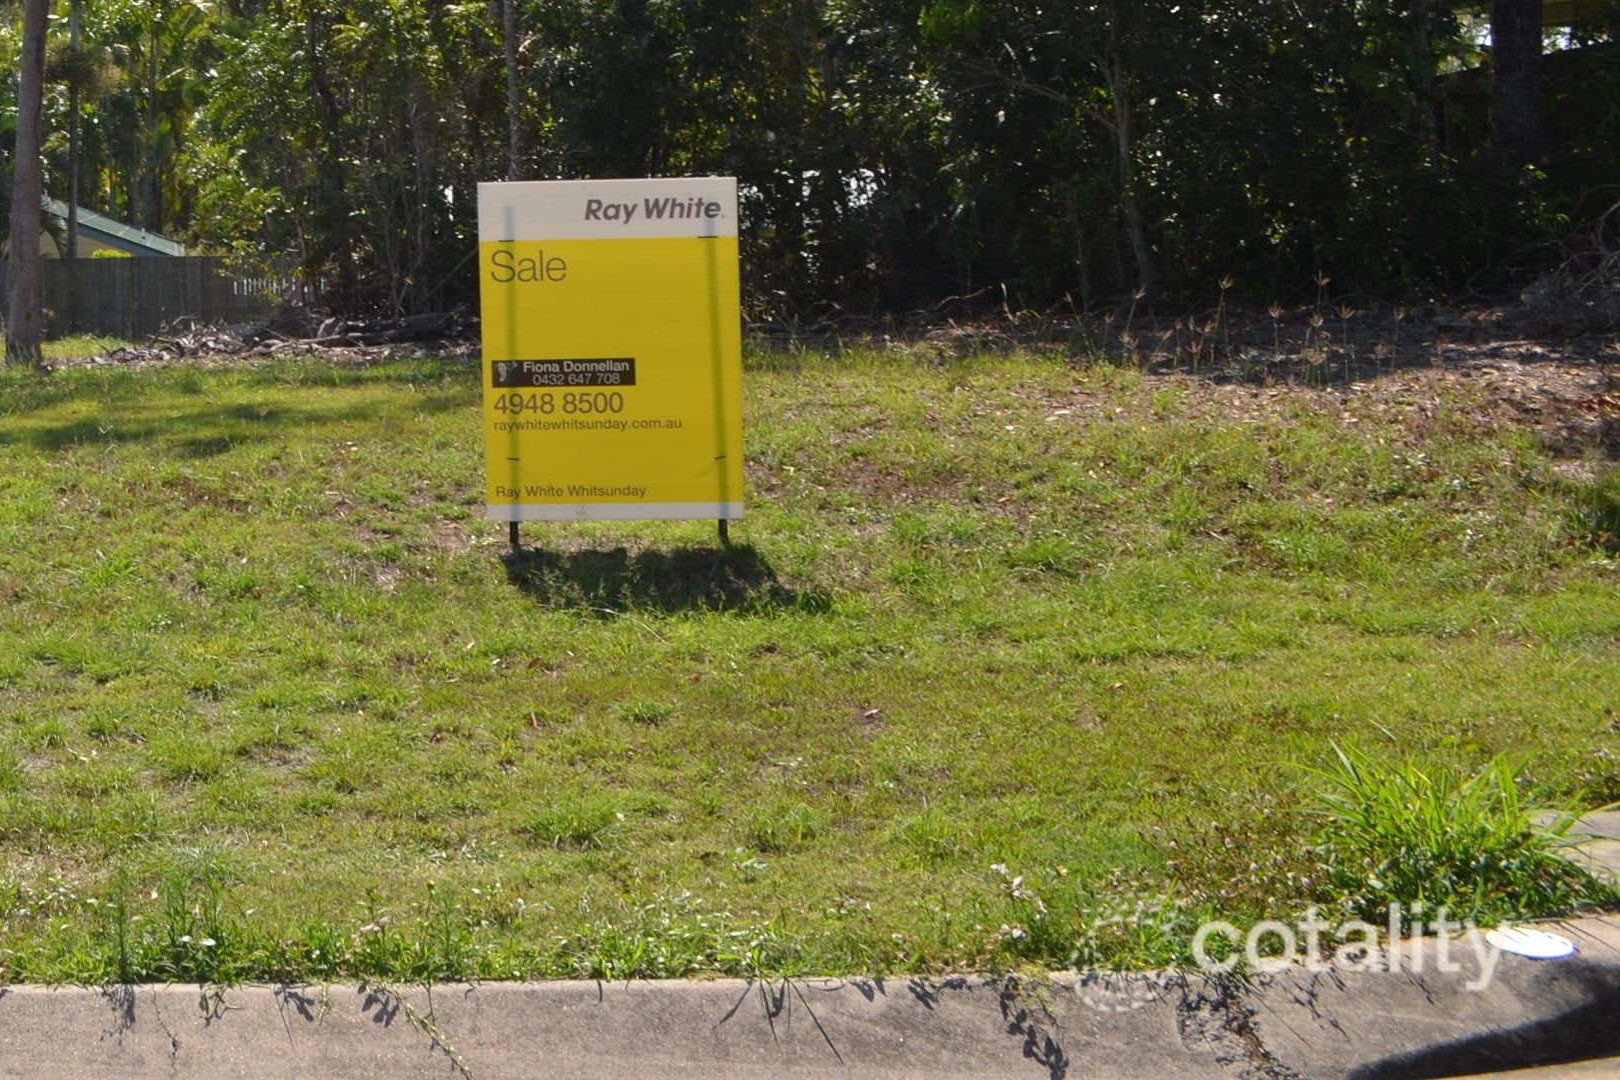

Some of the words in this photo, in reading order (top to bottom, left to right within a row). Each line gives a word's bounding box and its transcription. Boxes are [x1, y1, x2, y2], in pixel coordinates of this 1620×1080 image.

[584, 198, 638, 225] Ray
[644, 197, 722, 219] White
[490, 249, 568, 283] Sale
[523, 361, 560, 373] Fiona
[563, 360, 630, 372] Donnellan
[532, 373, 565, 386] 0432
[569, 373, 592, 385] 647
[596, 372, 621, 385] 708
[493, 393, 556, 415] 4948
[562, 392, 624, 414] 8500
[493, 418, 683, 434] raywhitewhitsunday.com.au
[496, 486, 521, 499] Ray
[526, 485, 564, 498] White
[567, 484, 648, 499] Whitsunday
